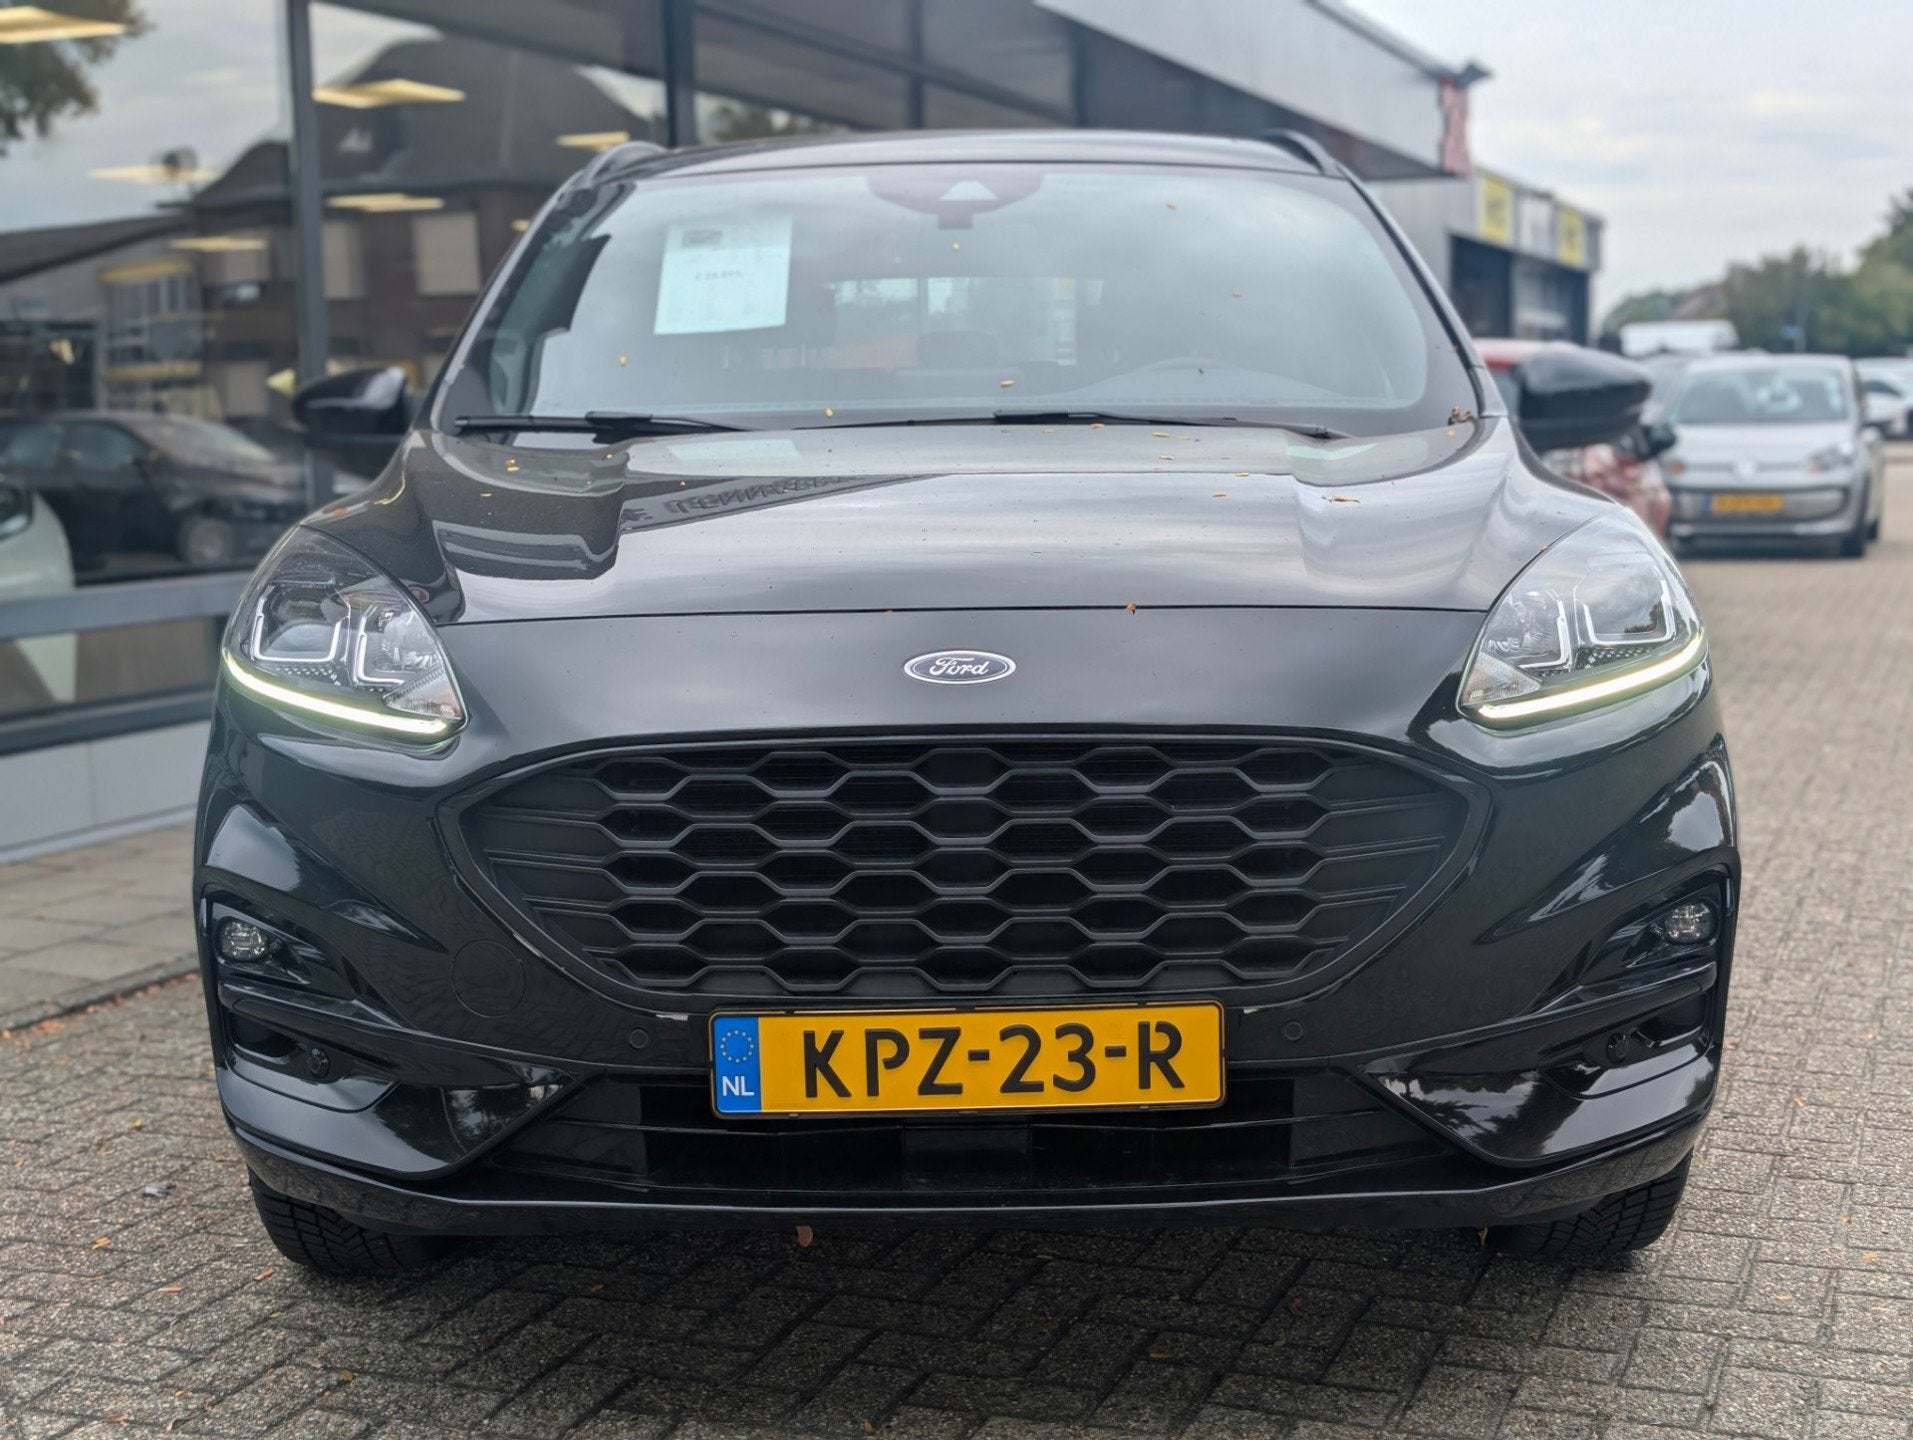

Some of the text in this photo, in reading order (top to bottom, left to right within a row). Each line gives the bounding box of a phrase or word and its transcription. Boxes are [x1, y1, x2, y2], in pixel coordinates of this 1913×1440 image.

[929, 657, 989, 676] Ford
[803, 1020, 1186, 1099] KPZ-23-R
[722, 1075, 755, 1097] NL
